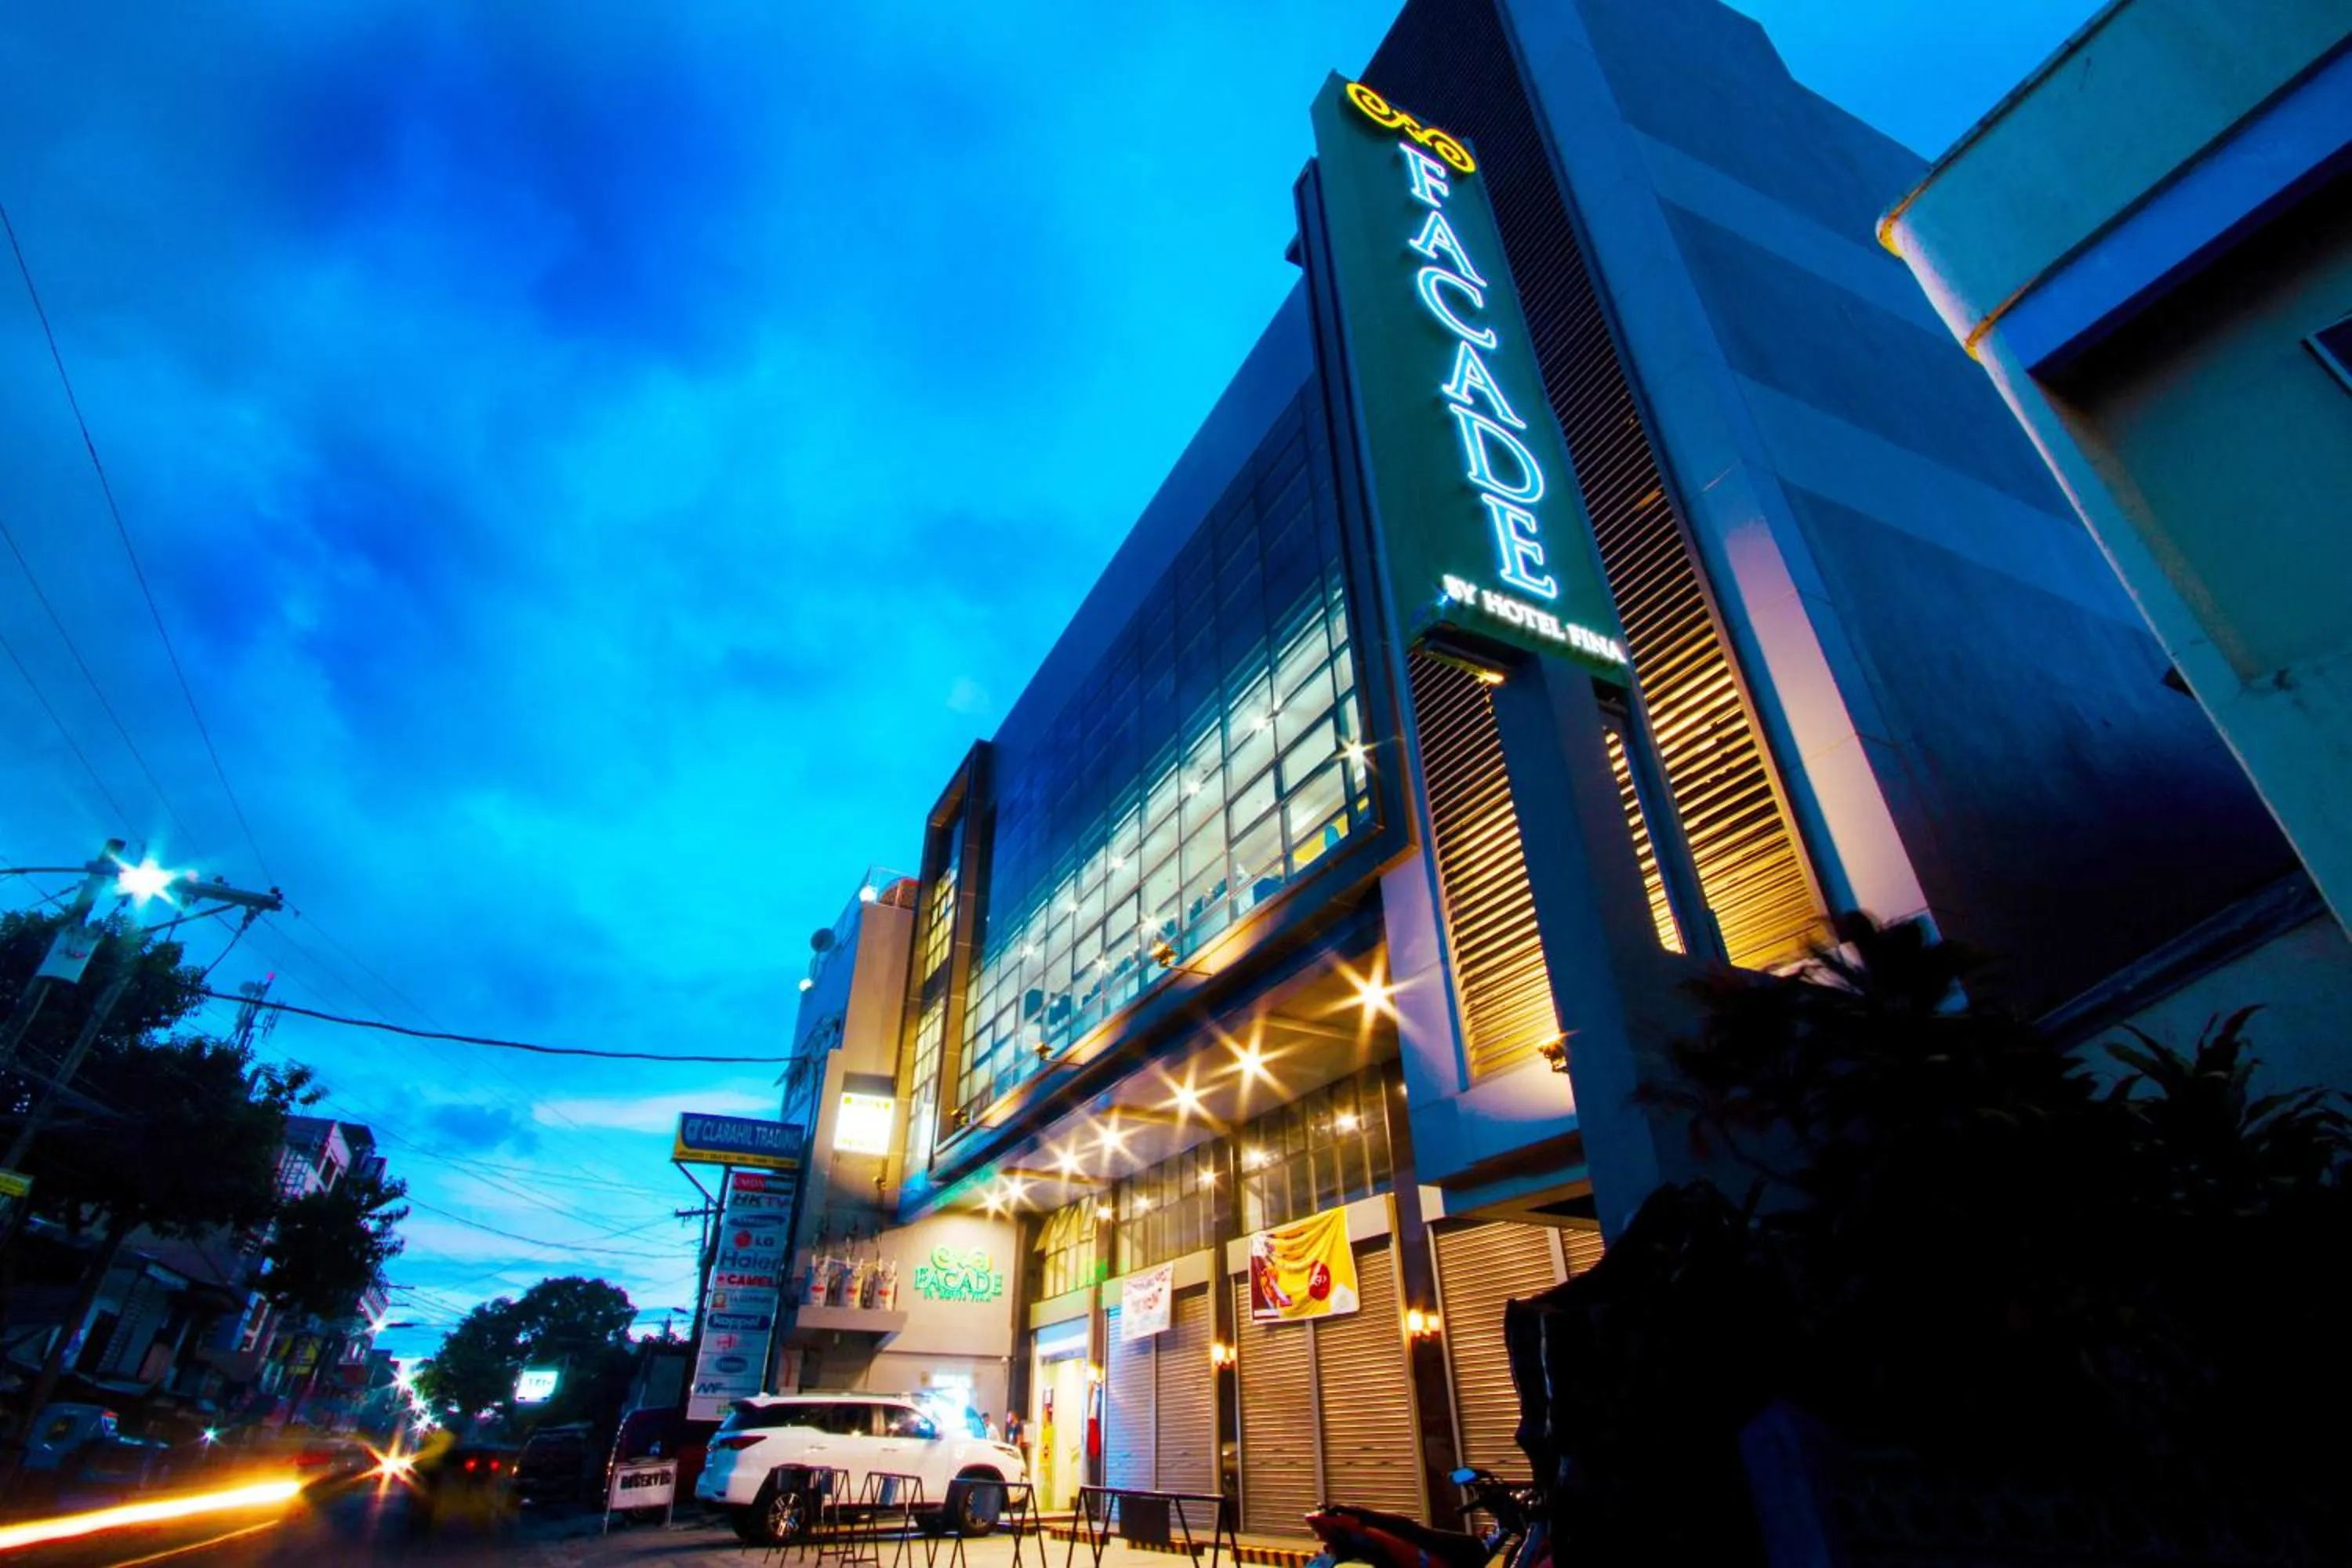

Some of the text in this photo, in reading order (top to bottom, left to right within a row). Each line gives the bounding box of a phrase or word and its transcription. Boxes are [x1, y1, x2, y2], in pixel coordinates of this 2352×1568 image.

[1397, 141, 1558, 600] FACADE
[1443, 573, 1628, 664] BY HOTEL FINA
[755, 1125, 800, 1150] TRADING
[755, 1236, 775, 1247] LG
[719, 1250, 782, 1270] Haier
[914, 1265, 1003, 1297] FACADE
